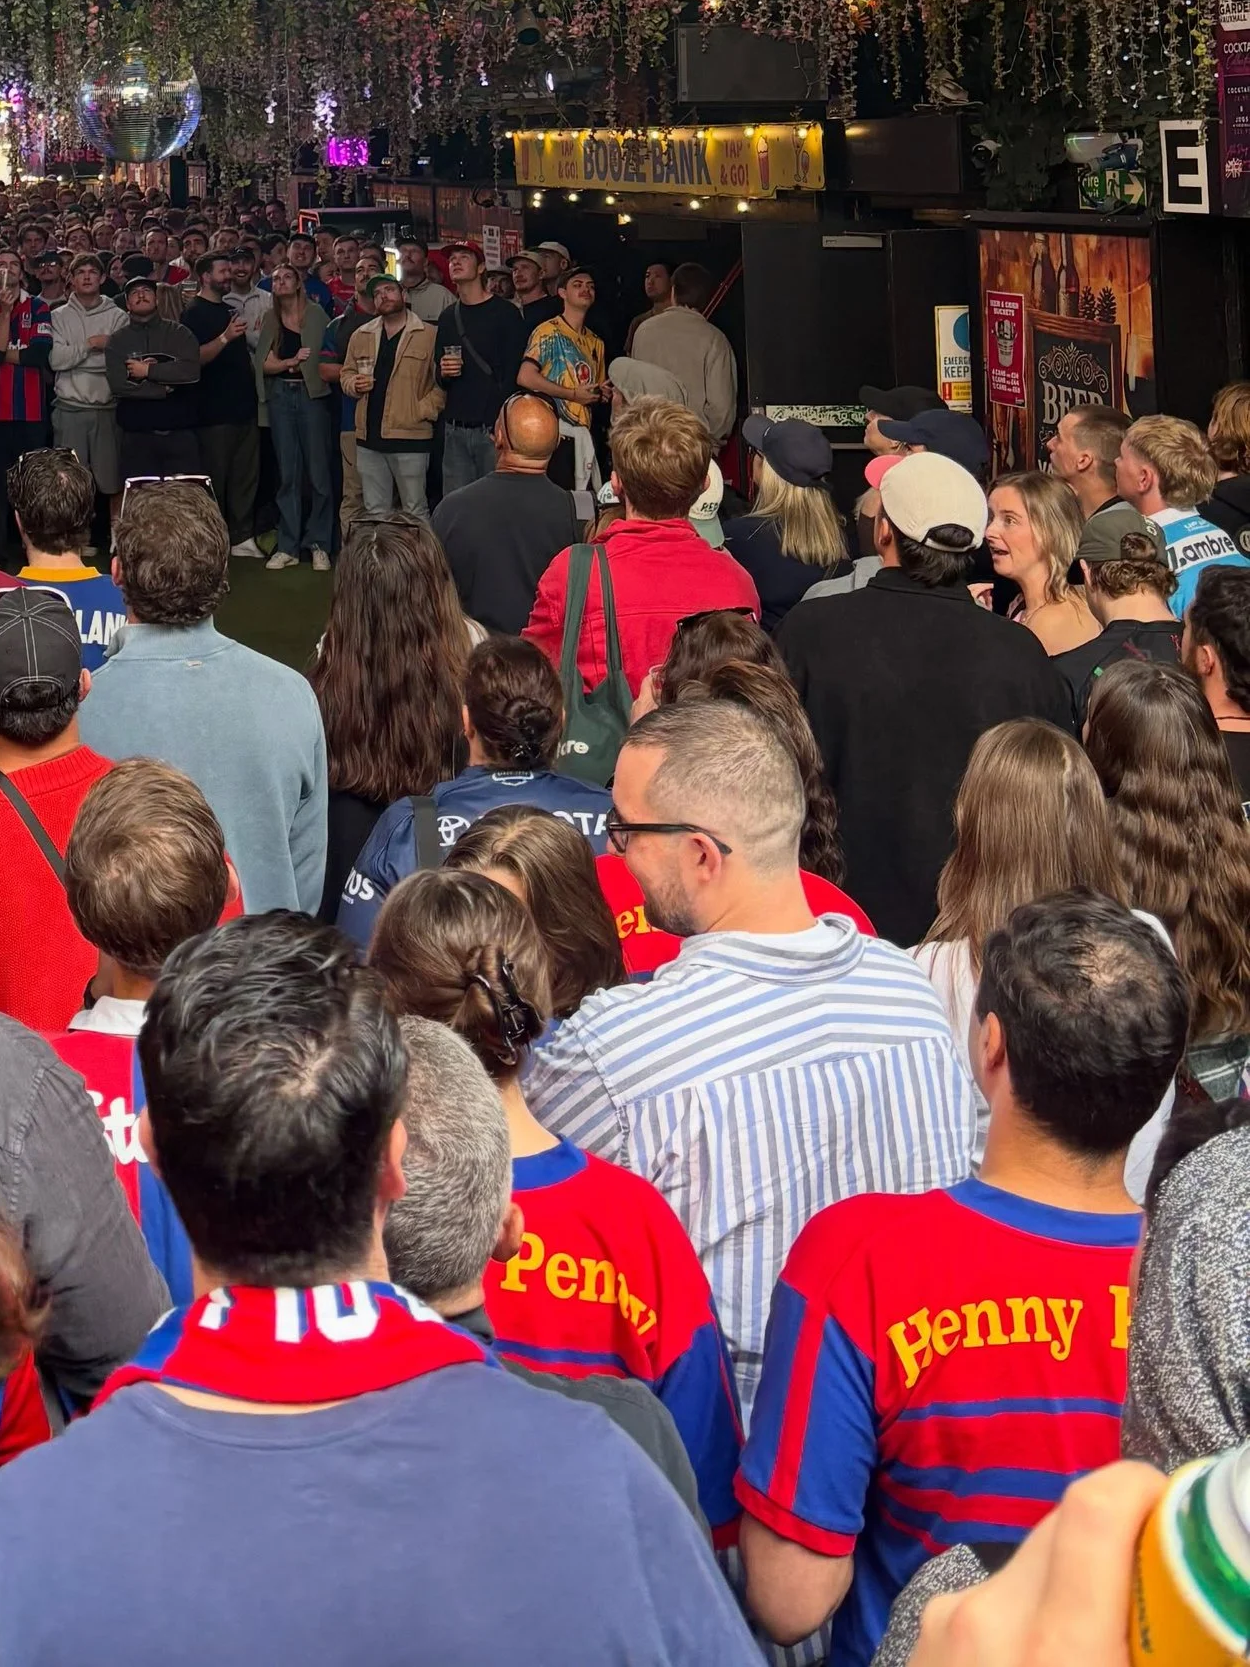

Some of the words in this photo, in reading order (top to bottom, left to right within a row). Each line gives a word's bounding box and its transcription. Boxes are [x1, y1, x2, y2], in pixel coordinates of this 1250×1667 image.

[560, 140, 573, 157] TAP
[723, 140, 742, 158] TAP
[652, 137, 712, 184] BANK
[1165, 128, 1203, 205] E
[558, 165, 565, 179] &
[565, 165, 578, 180] GO!
[720, 165, 729, 183] &
[730, 164, 749, 184] GO!
[945, 366, 970, 378] KEEP
